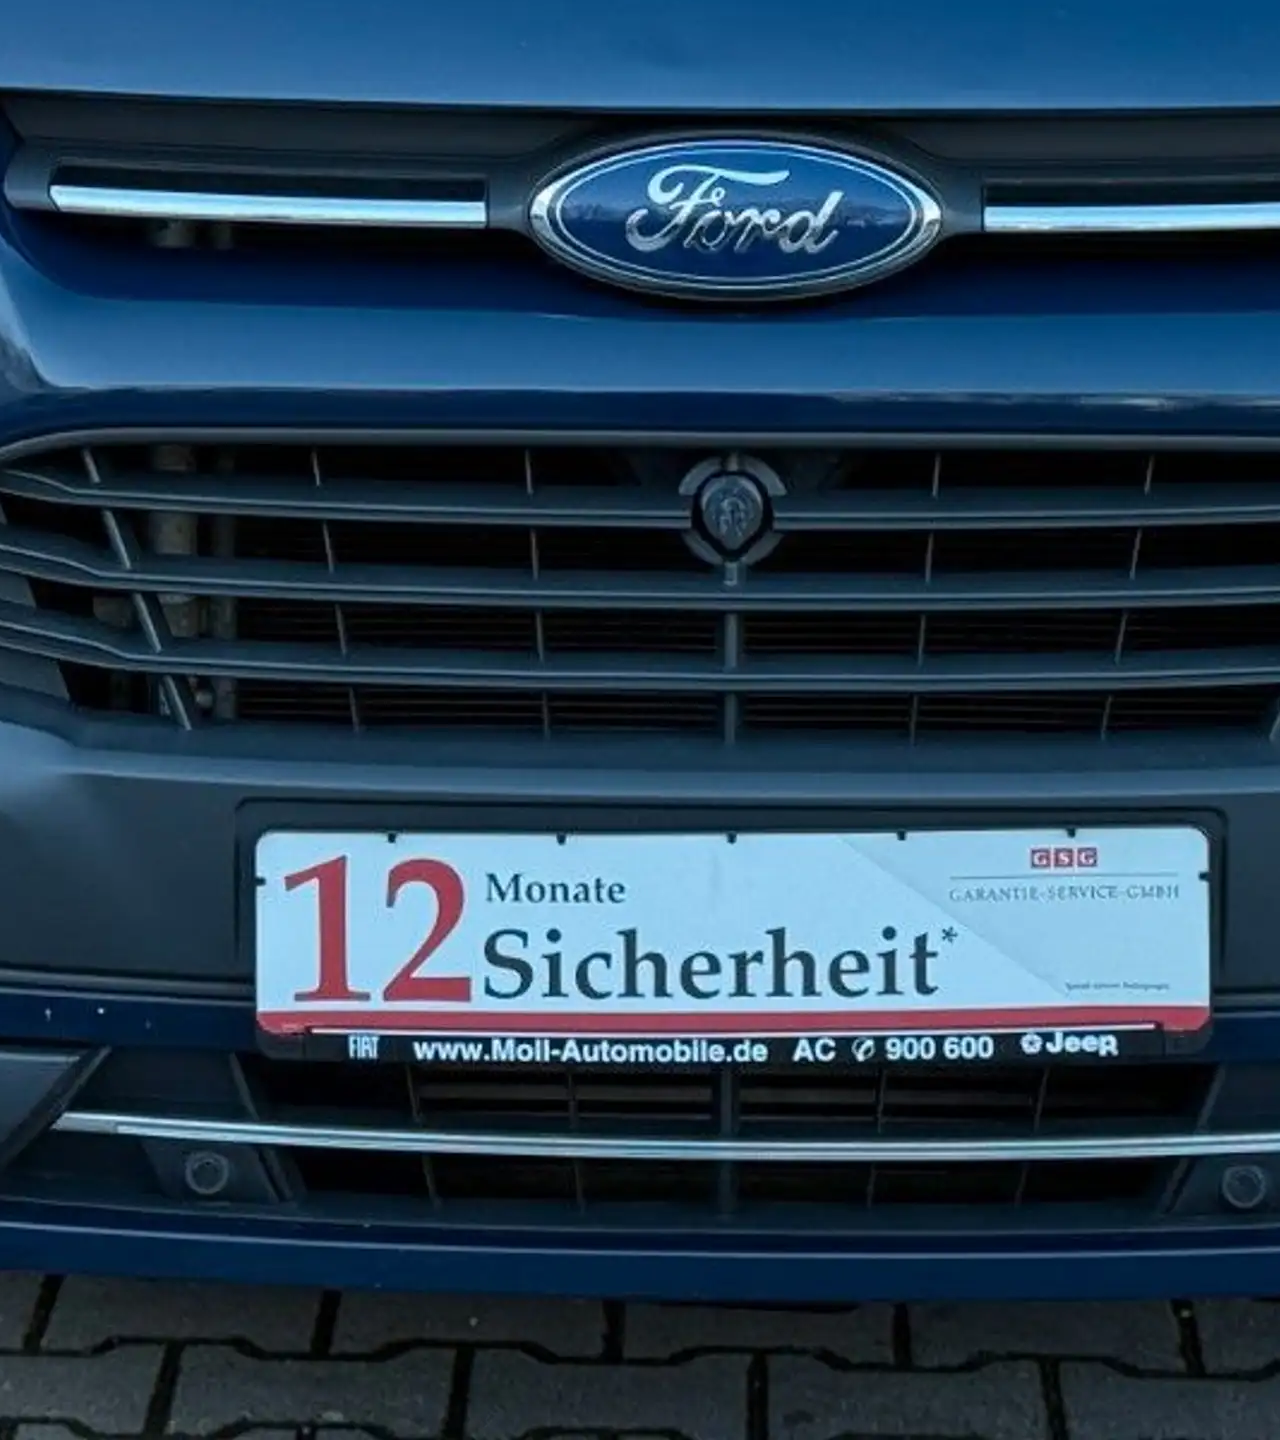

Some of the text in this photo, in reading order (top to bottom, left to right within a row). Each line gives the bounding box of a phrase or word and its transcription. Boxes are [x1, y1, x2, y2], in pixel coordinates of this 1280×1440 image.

[626, 164, 842, 255] Ford
[1032, 849, 1096, 867] GSG
[485, 873, 626, 903] Monate
[284, 855, 472, 1001] 12
[348, 1035, 380, 1060] FIAT
[412, 1035, 995, 1063] www.Moll-Automobile.de AC 900 600
[1044, 1031, 1120, 1057] Jeep
